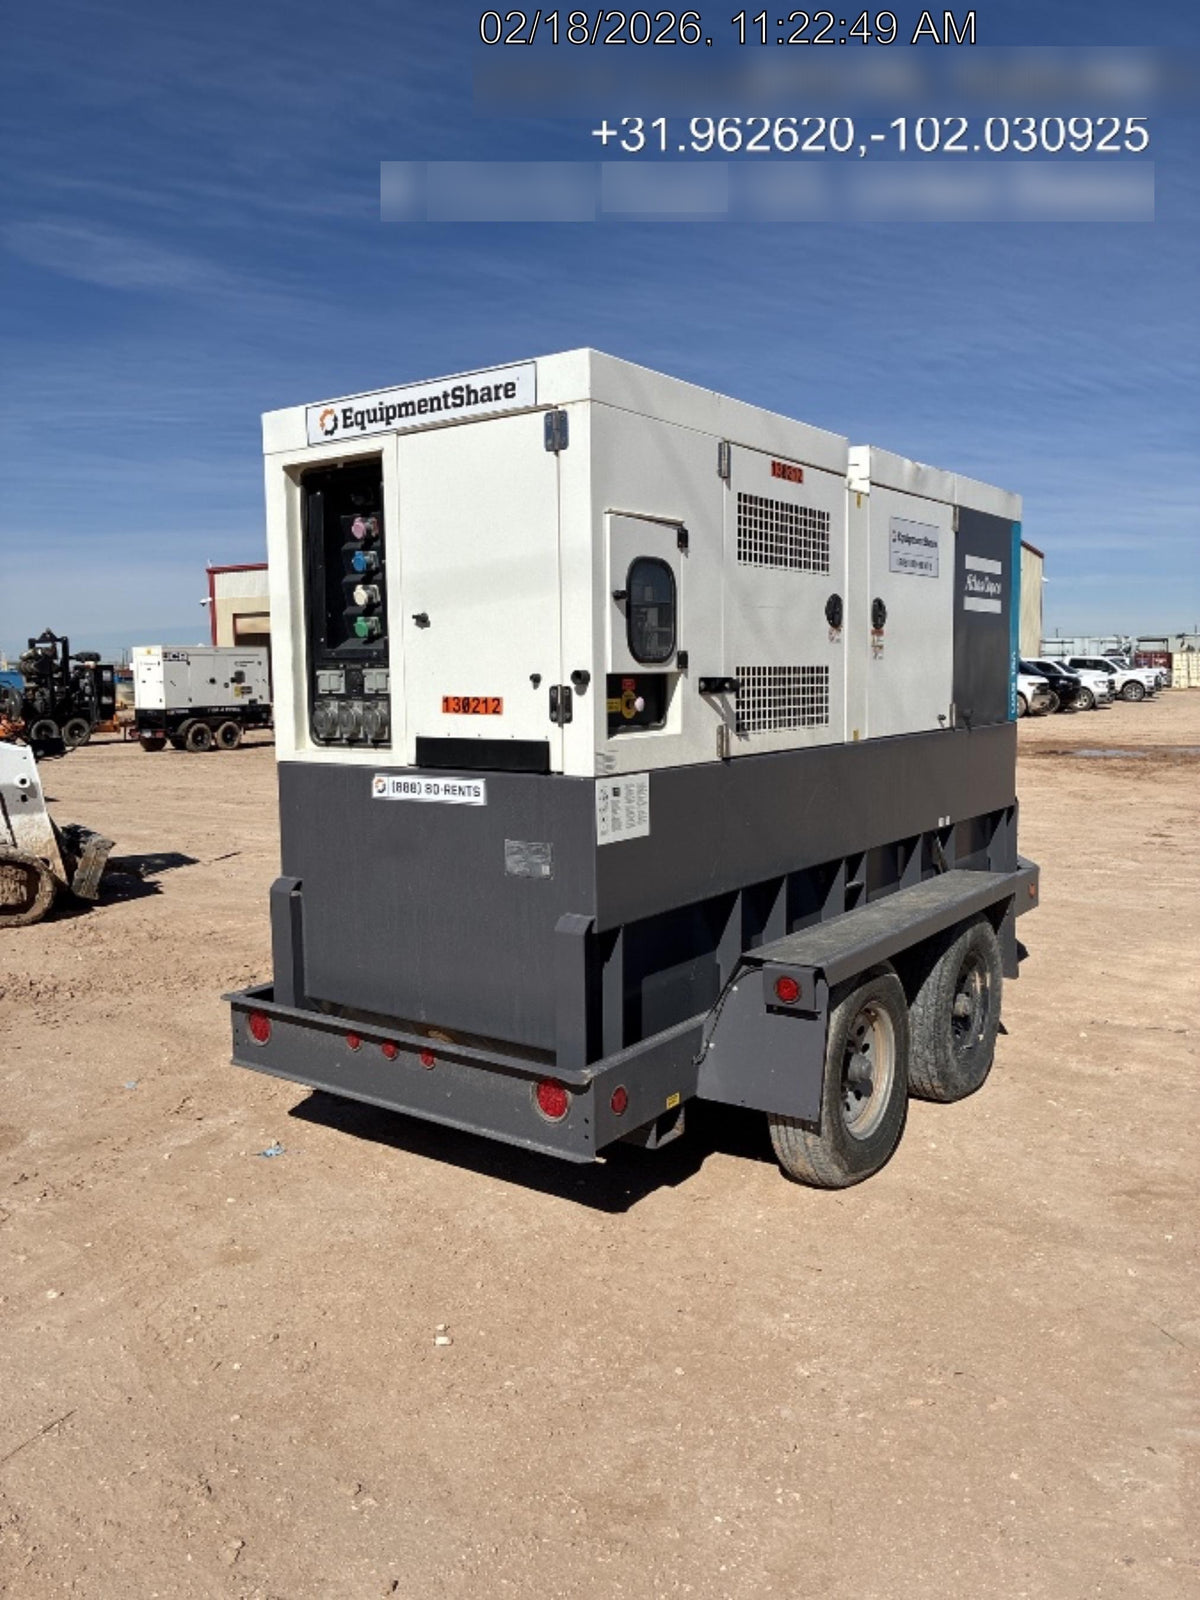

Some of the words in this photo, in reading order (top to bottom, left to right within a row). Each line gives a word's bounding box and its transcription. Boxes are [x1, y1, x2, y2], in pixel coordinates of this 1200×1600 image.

[341, 381, 516, 430] EquipmentShare
[442, 696, 502, 714] 130212
[392, 781, 421, 795] (888)
[424, 783, 481, 797] 80-RENTS
